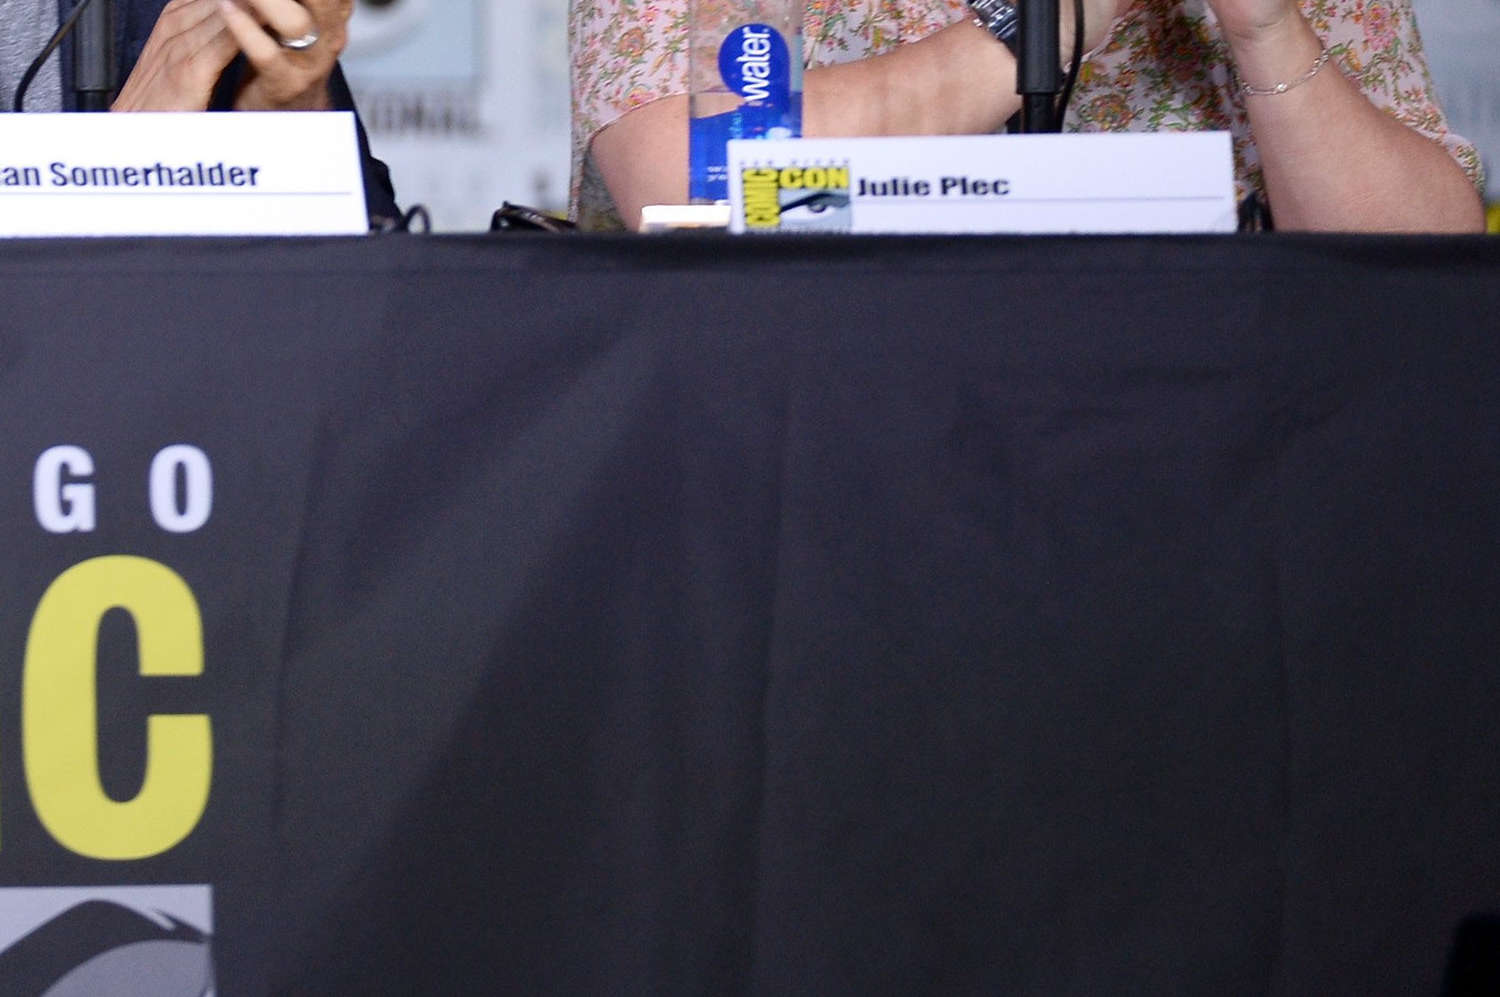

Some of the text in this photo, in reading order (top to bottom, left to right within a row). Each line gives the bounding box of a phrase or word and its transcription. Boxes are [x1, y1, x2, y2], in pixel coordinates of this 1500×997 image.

[49, 162, 259, 187] Somerhalder
[779, 167, 849, 189] CON
[857, 177, 1010, 196] Julie Plec
